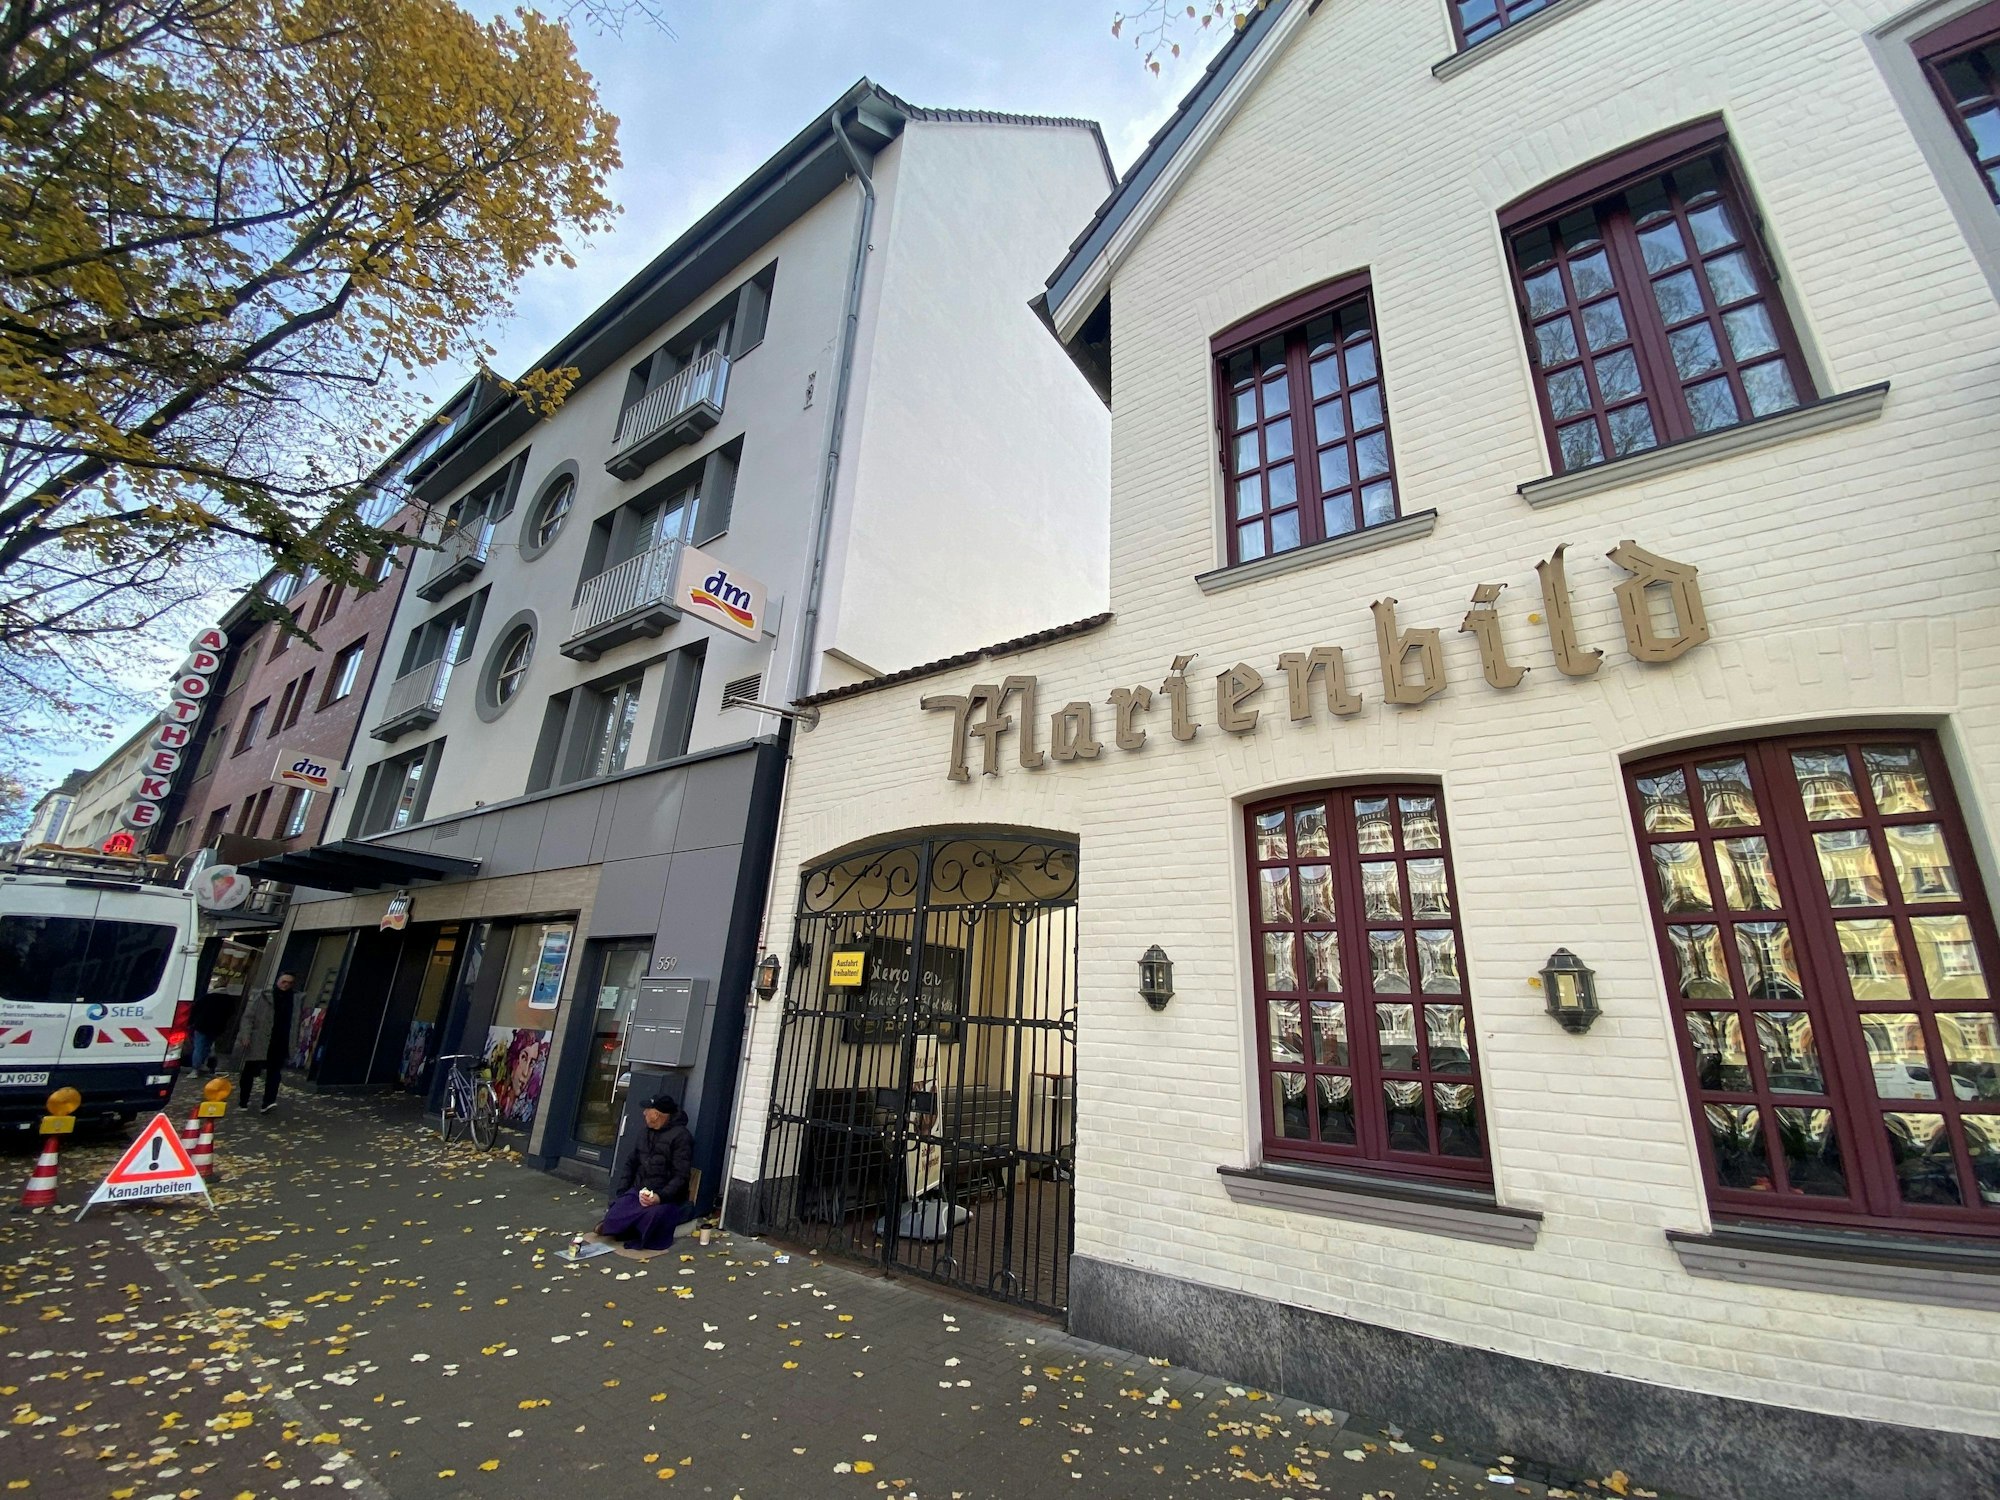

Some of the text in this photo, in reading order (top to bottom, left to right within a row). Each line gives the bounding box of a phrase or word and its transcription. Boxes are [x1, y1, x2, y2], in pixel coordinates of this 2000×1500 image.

[703, 570, 751, 611] dm
[919, 540, 1710, 782] Marienbild
[131, 631, 221, 823] APOTHEKE
[292, 758, 327, 777] dm
[656, 956, 677, 971] 559
[836, 959, 859, 967] Ausfahrt
[833, 968, 859, 977] freihalten!
[111, 1006, 144, 1018] StEB
[17, 1073, 47, 1084] 9039
[108, 1181, 192, 1199] Kanalarbeiten
